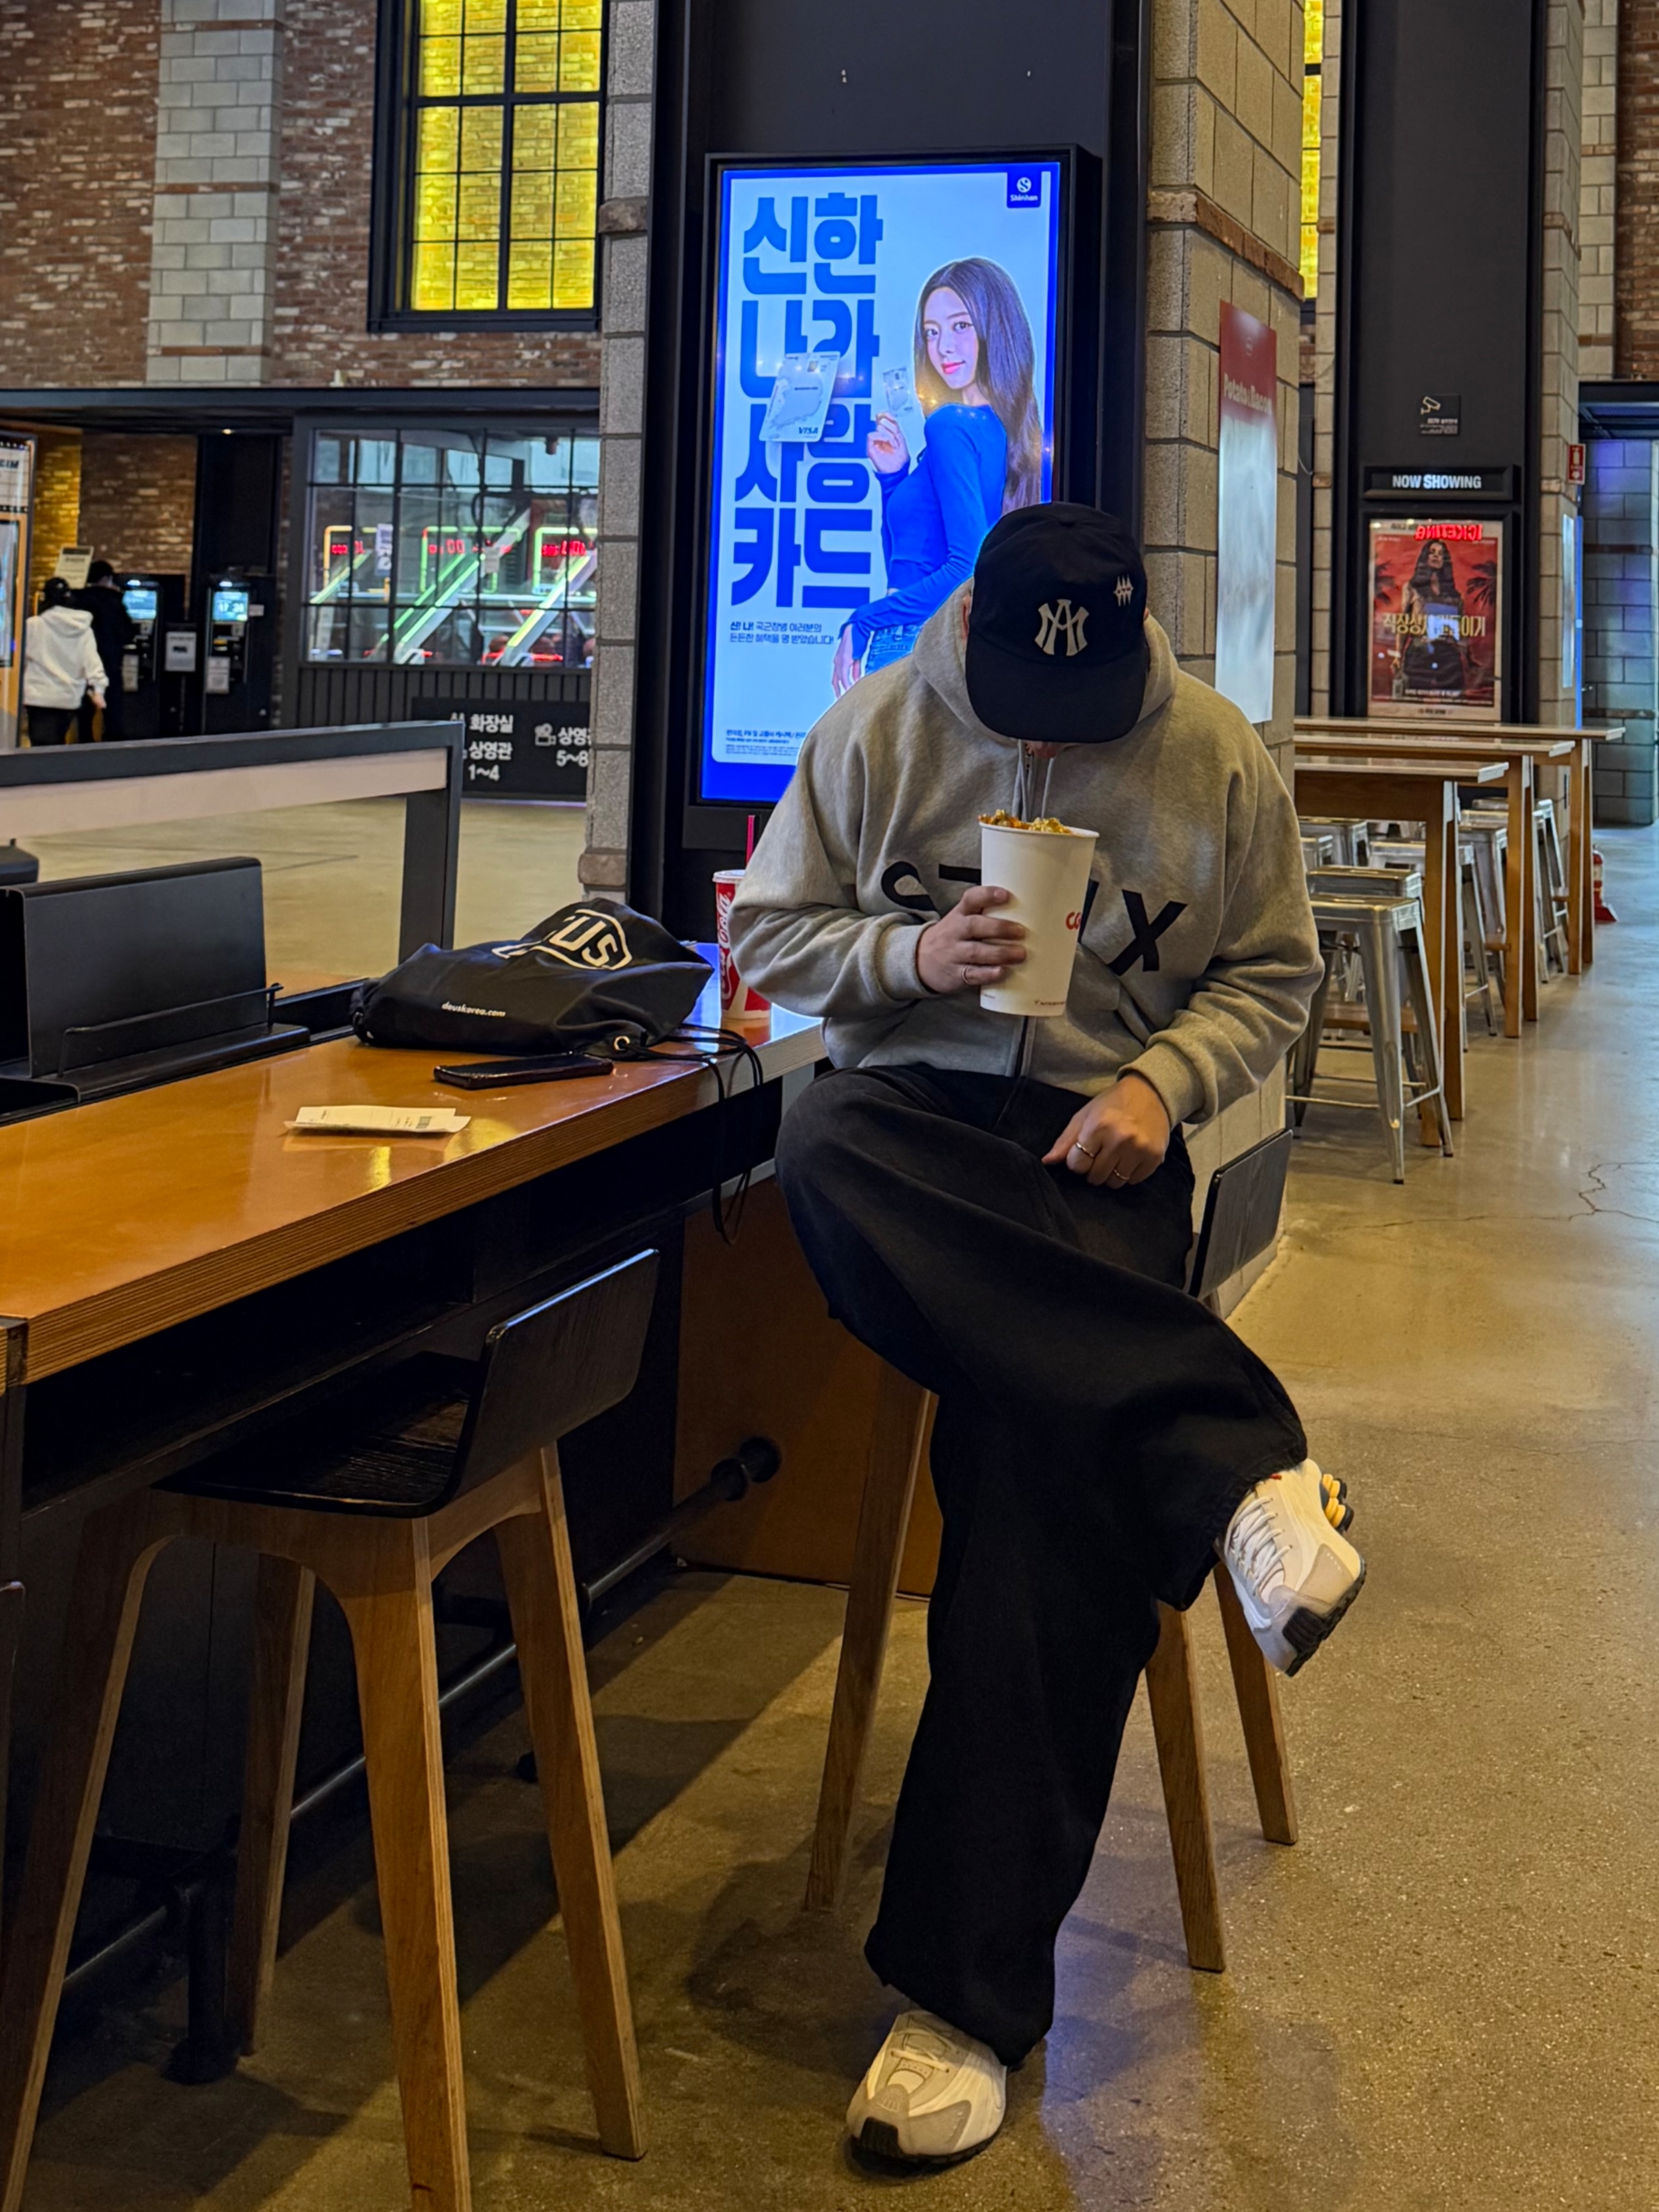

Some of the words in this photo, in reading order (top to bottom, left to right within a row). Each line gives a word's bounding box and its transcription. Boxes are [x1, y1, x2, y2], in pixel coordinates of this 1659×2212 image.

[742, 193, 883, 295] 신한
[740, 299, 880, 398] 나라
[1224, 372, 1247, 405] Potato
[798, 426, 819, 435] VISA
[1392, 475, 1422, 488] NOW
[1423, 475, 1482, 489] SHOWING
[731, 508, 873, 609] 카드
[789, 623, 822, 633] 여러분의
[730, 633, 753, 643] 든든한
[469, 714, 513, 733] 화장실
[558, 727, 592, 746] 상영
[468, 741, 513, 760] 상영관
[556, 750, 589, 767] 5~8
[468, 764, 499, 781] 1~4
[441, 1001, 506, 1017] deuskorea.com
